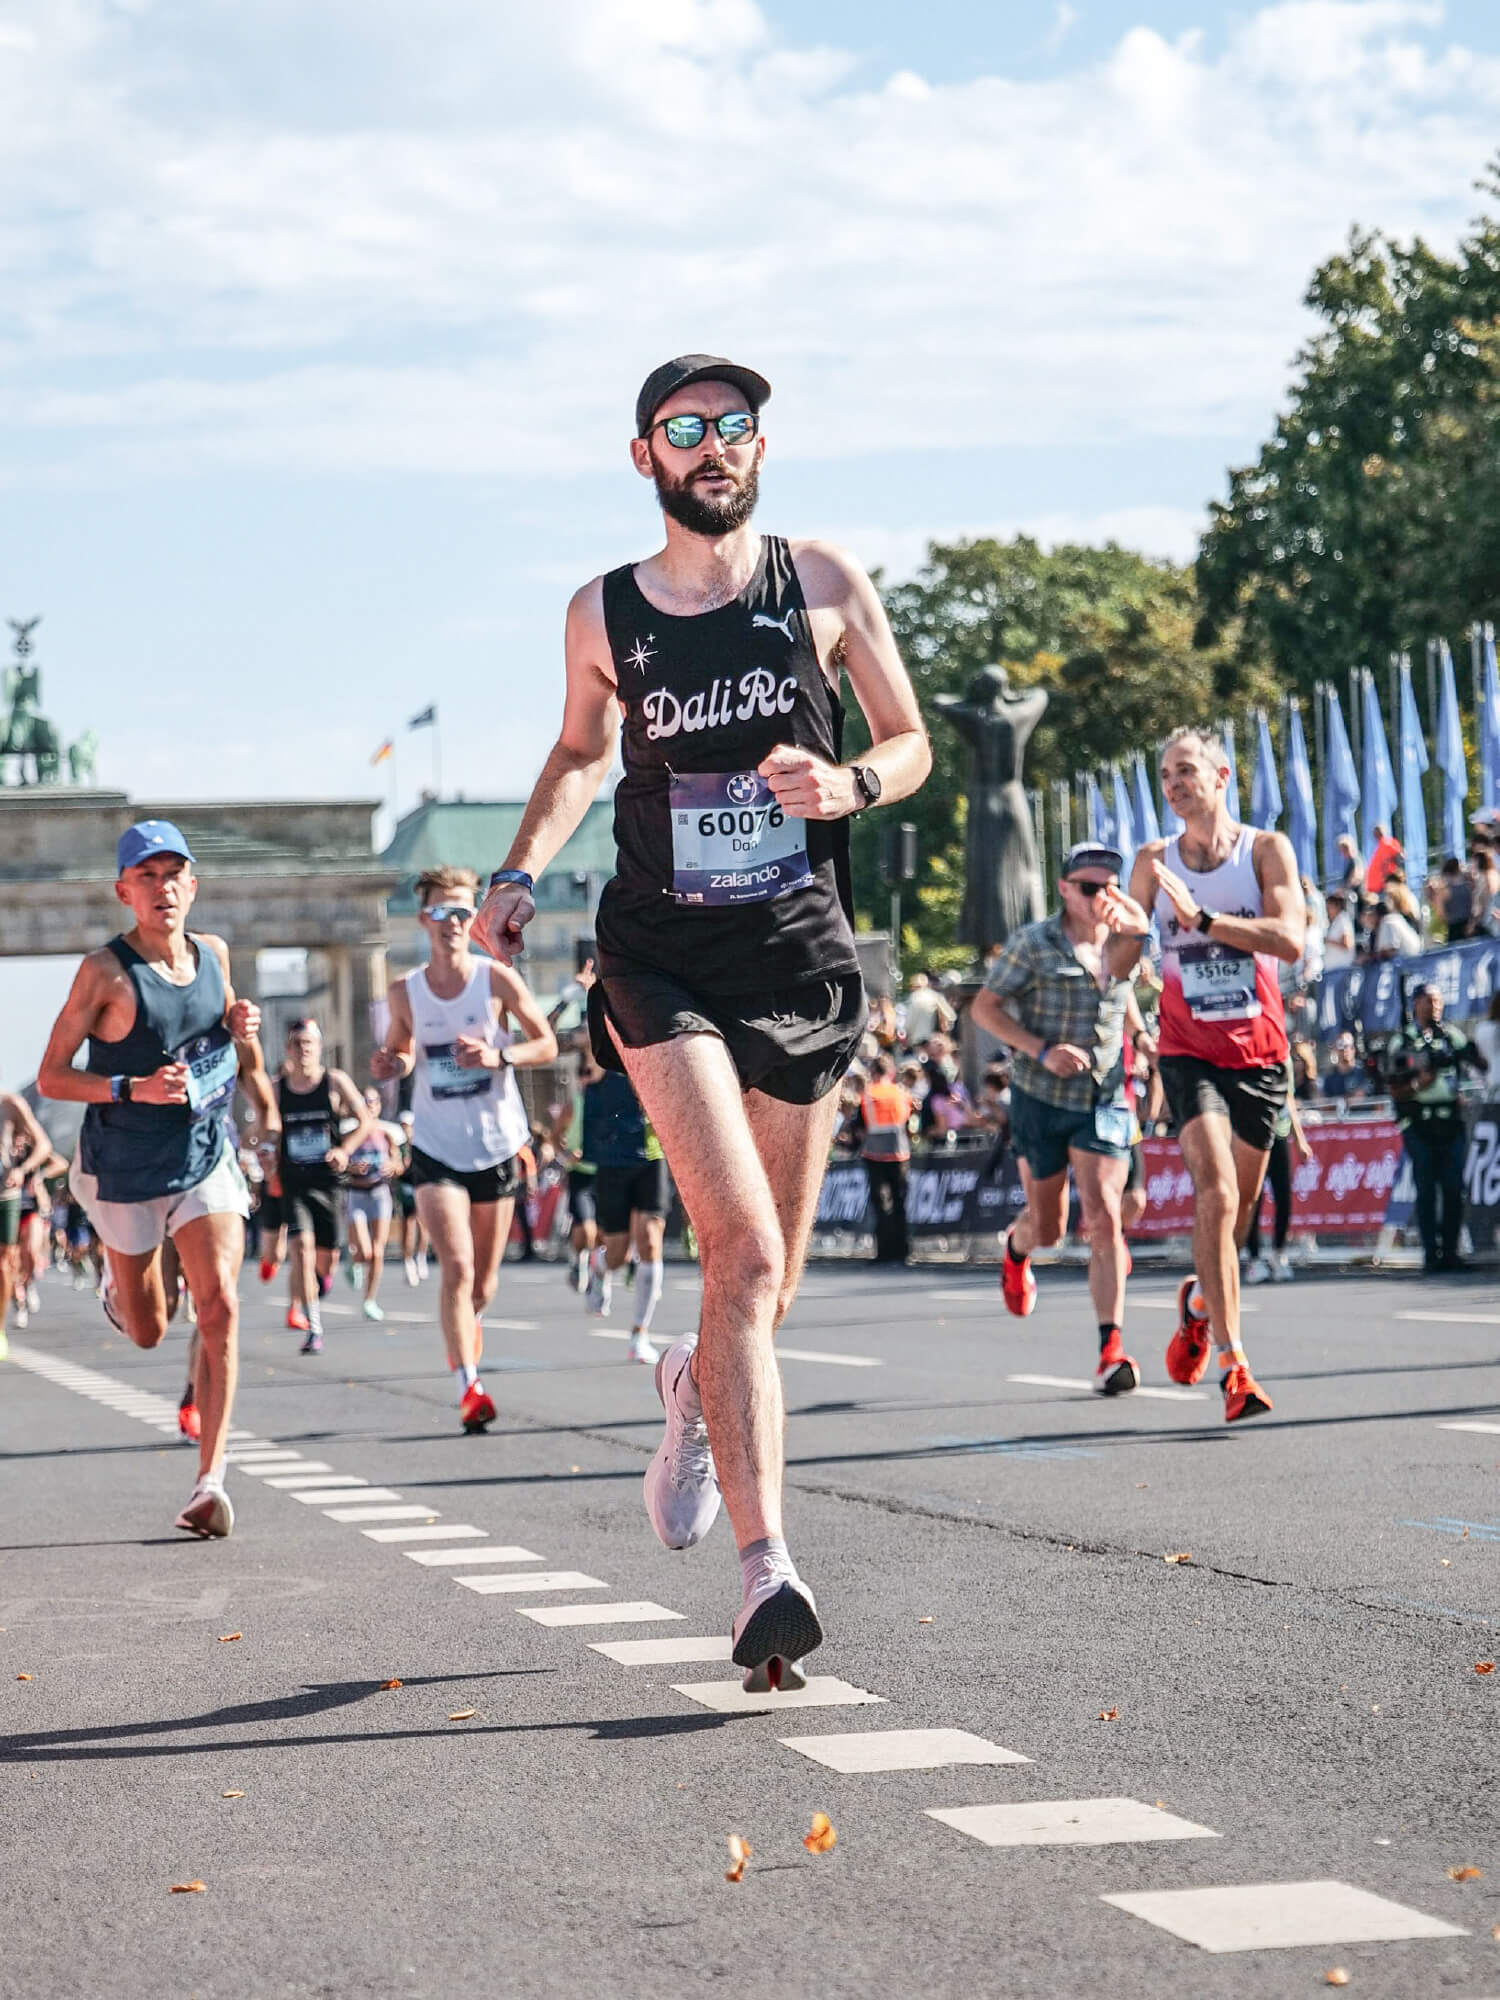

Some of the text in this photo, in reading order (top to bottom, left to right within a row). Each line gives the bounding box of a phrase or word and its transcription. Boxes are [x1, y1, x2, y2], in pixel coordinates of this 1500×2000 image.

[643, 679, 732, 741] Dali
[698, 804, 785, 837] 60076
[710, 865, 781, 888] zalando
